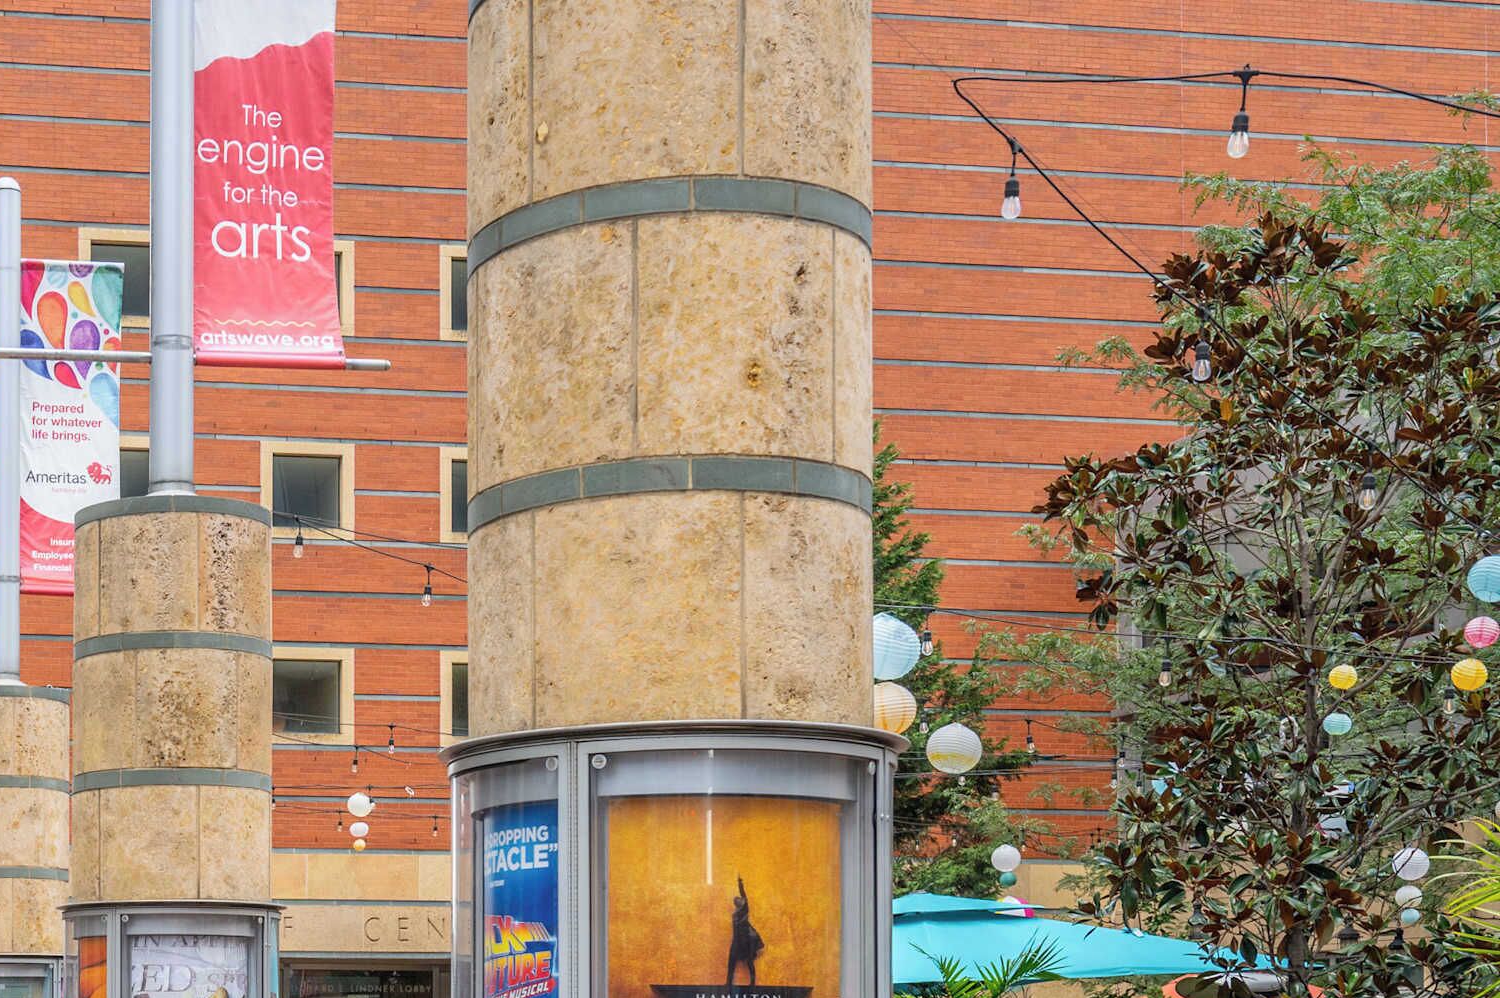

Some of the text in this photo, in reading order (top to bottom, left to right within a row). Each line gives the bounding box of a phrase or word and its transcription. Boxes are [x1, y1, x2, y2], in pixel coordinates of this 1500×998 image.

[243, 105, 282, 128] The
[197, 136, 325, 174] engine
[223, 182, 298, 207] for the
[211, 213, 312, 263] arts
[201, 331, 335, 349] artswave.org
[32, 401, 84, 414] Prepared
[32, 416, 103, 428] for whatever
[32, 429, 91, 443] life brings.
[25, 470, 87, 484] Ameritas
[400, 984, 432, 993] LOBBY
